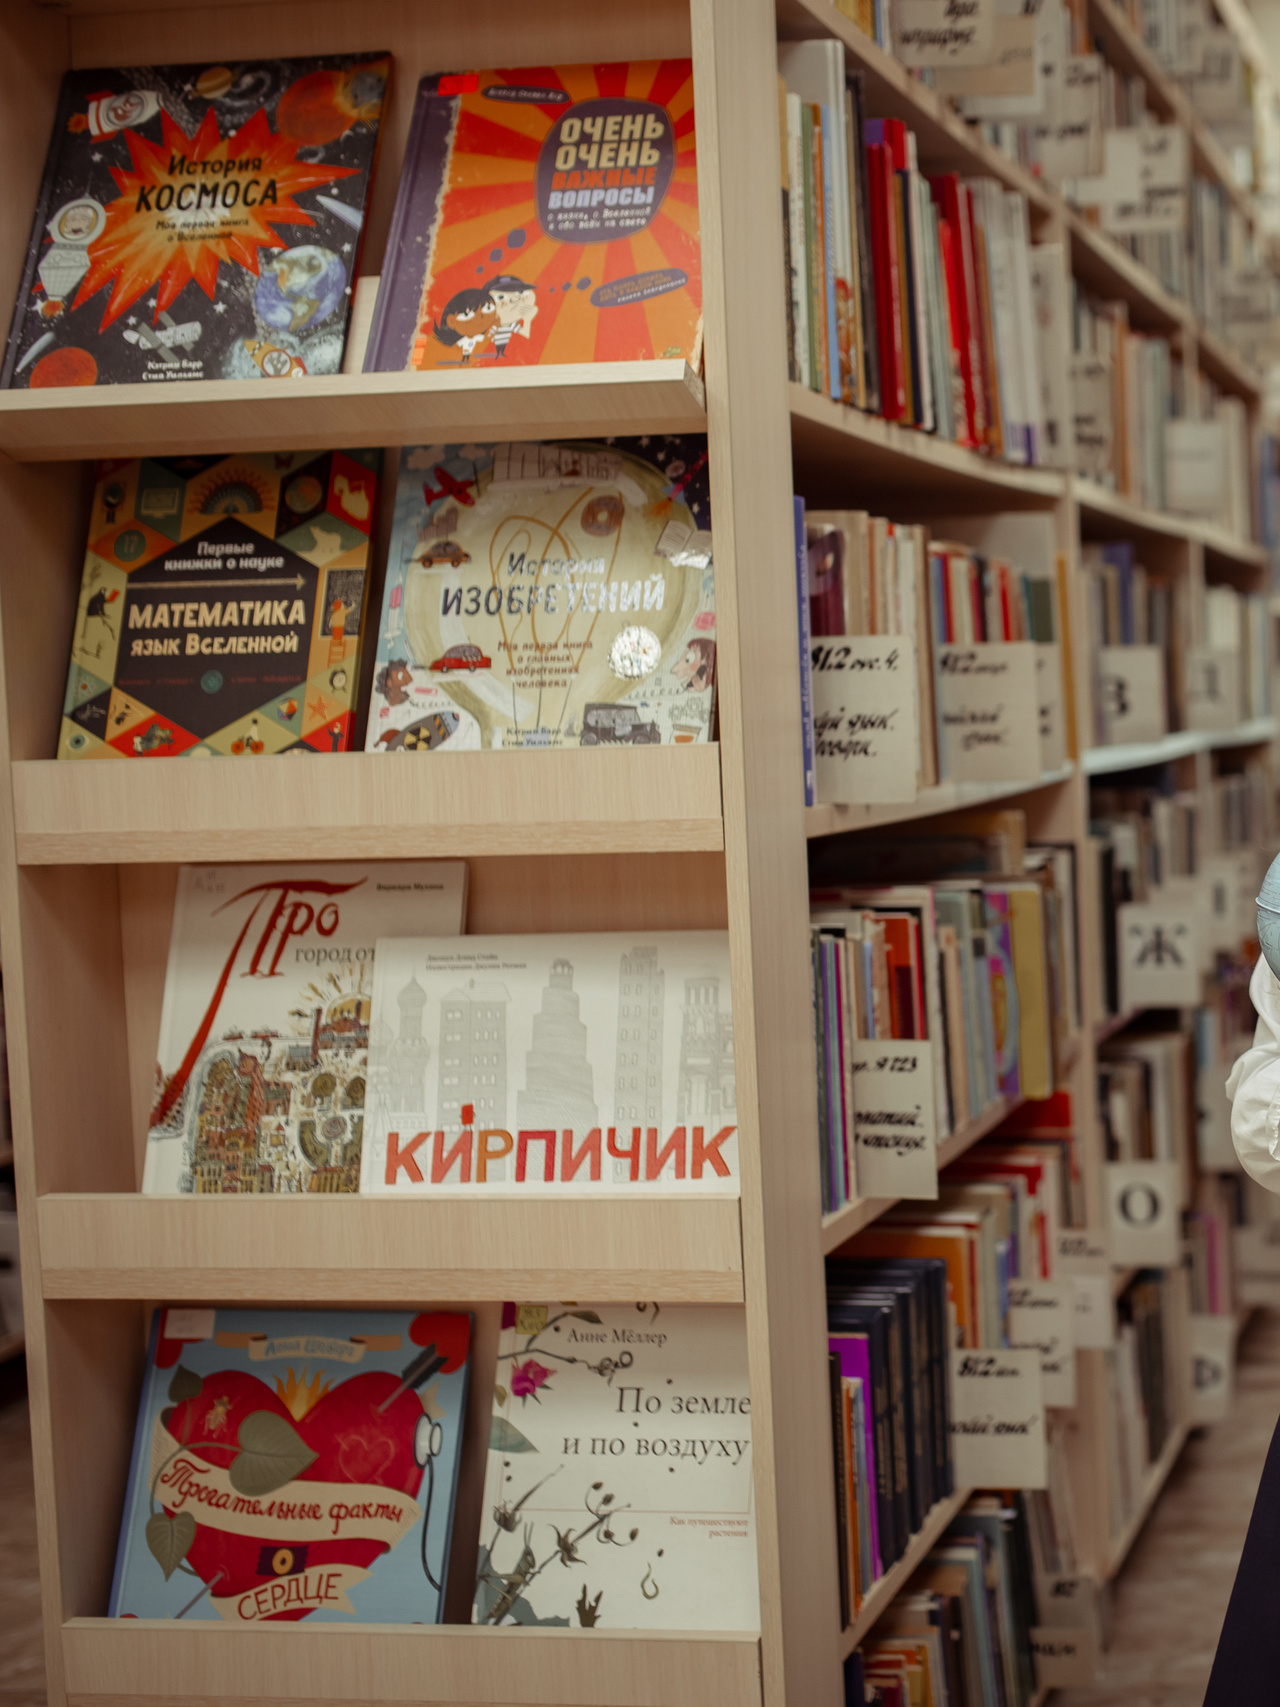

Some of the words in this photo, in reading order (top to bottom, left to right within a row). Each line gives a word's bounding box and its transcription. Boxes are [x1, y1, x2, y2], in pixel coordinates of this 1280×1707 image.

[559, 113, 666, 144] ОЧЕНЬ
[167, 154, 263, 178] История
[555, 139, 661, 171] ОЧЕНЬ
[552, 166, 658, 190] ВАЖНЫЕ
[135, 179, 278, 213] КОСМОСА
[548, 186, 655, 210] ВОПРОСЫ
[164, 556, 222, 571] книжки
[226, 557, 236, 570] о
[239, 554, 284, 574] науке
[197, 541, 254, 558] Первые
[441, 573, 665, 617] ИЗОБРЕТЕНИЙ
[128, 599, 306, 630] МАТЕМАТИКА
[295, 946, 353, 966] город
[385, 1125, 738, 1185] КИРПИЧИК
[567, 1329, 608, 1344] Анне
[611, 1328, 668, 1349] Мёллер
[615, 1386, 661, 1415] По
[670, 1396, 751, 1415] земле
[562, 1437, 580, 1455] и
[590, 1437, 625, 1456] по
[635, 1437, 751, 1466] воздуху
[161, 1458, 323, 1523] Трогательные
[328, 1499, 404, 1535] факты
[238, 1573, 343, 1621] СЕРДЦЕ
